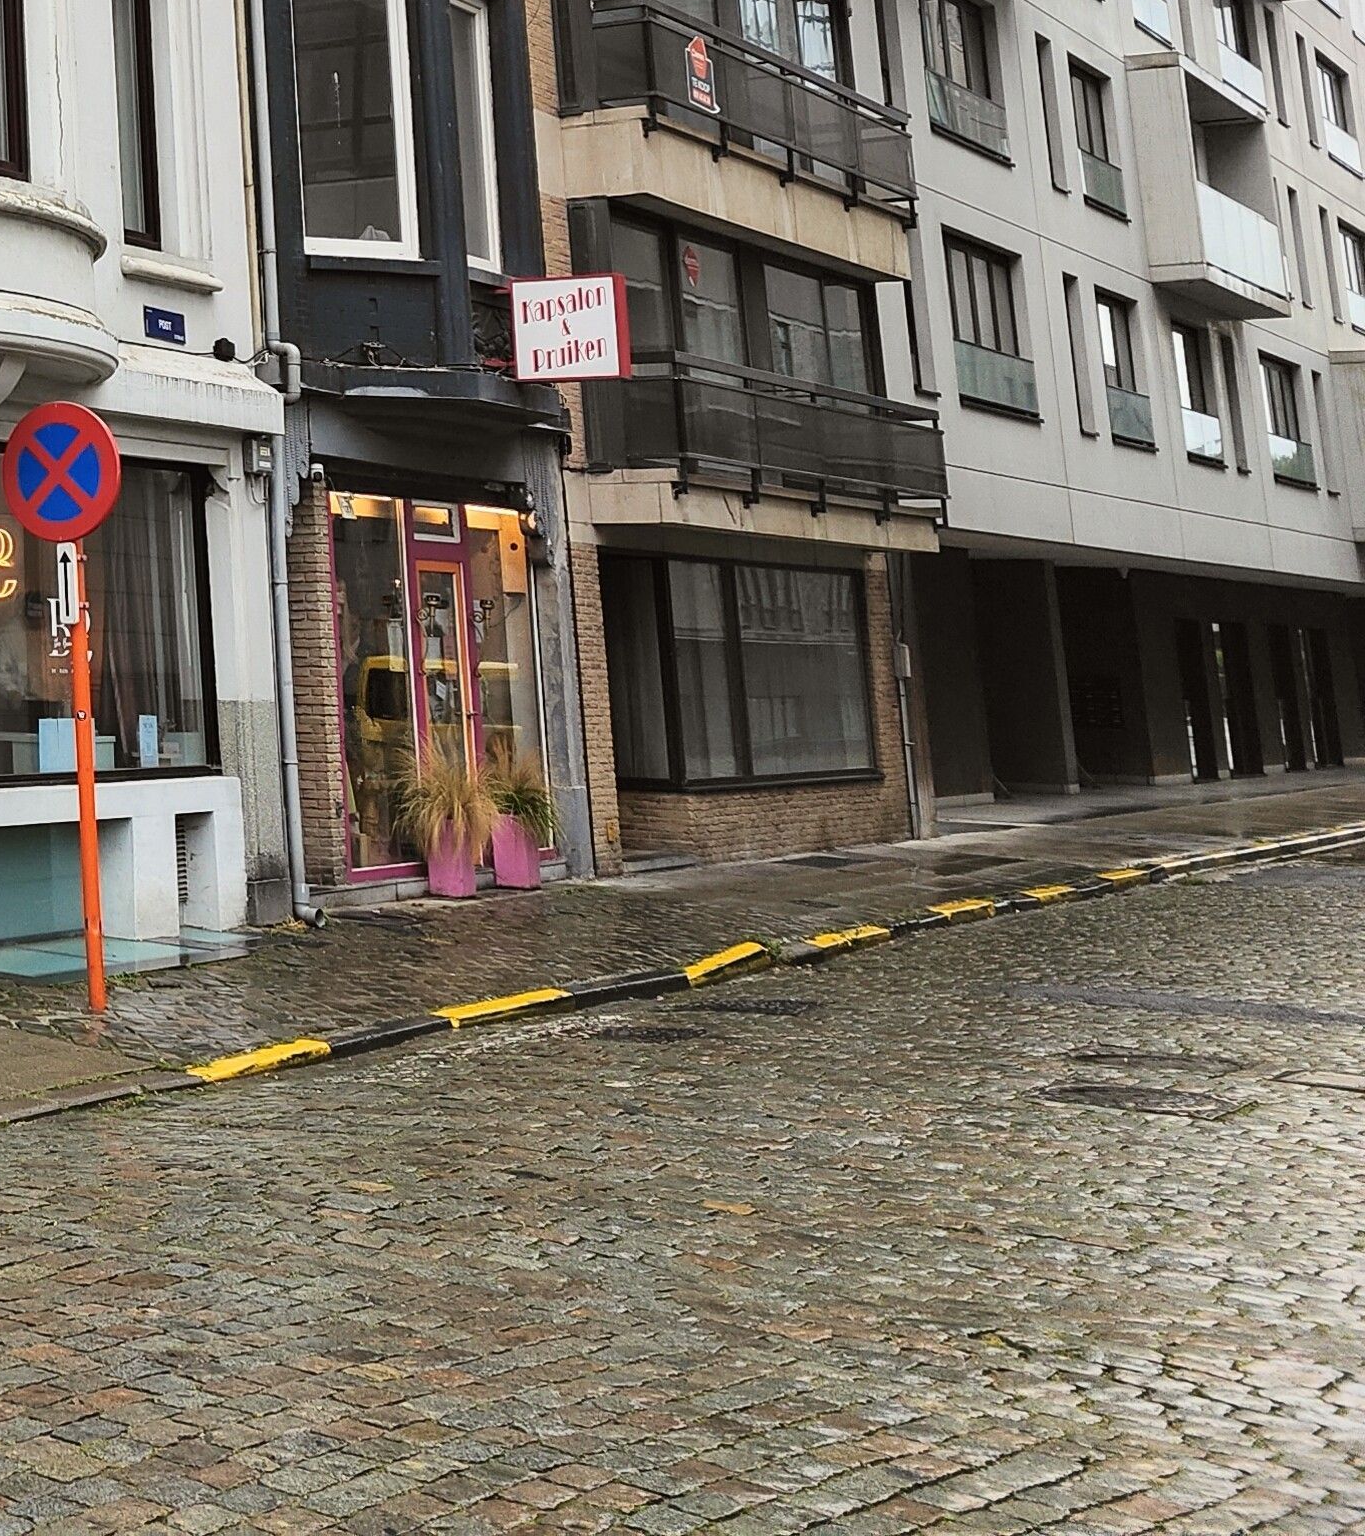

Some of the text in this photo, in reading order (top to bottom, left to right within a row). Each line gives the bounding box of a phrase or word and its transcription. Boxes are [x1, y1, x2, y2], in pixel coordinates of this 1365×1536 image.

[522, 286, 607, 324] Kapsalon
[158, 318, 172, 331] POST
[562, 318, 571, 336] &
[533, 338, 607, 372] Pruiken
